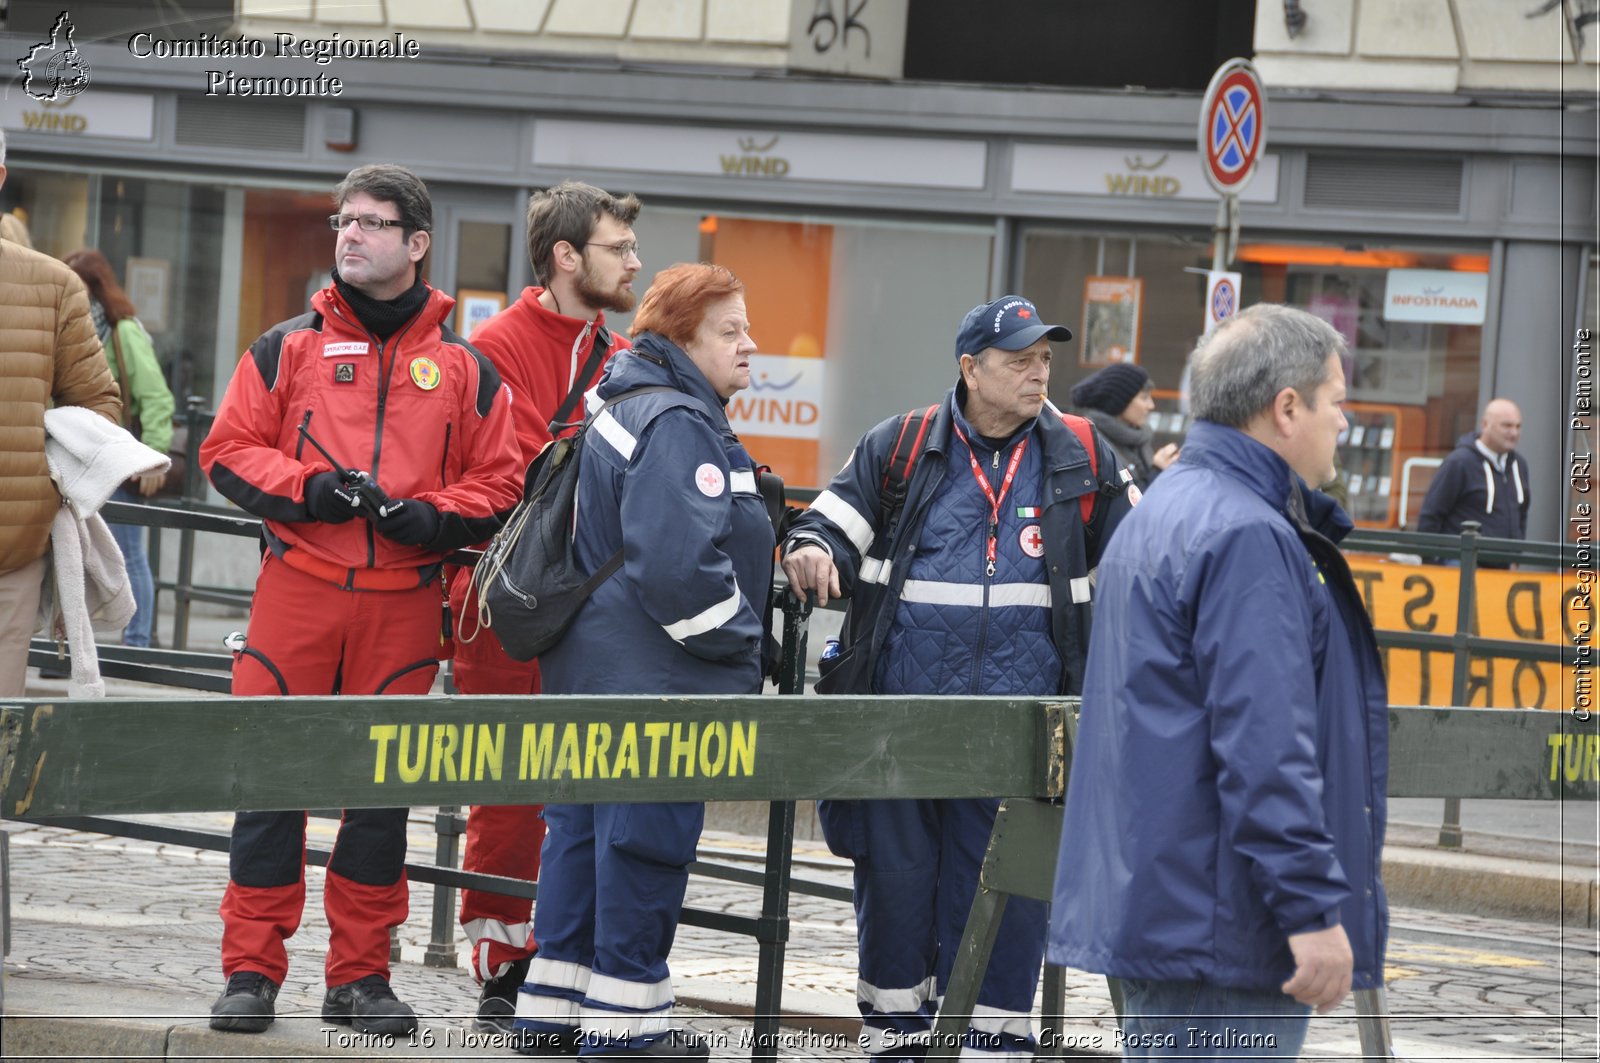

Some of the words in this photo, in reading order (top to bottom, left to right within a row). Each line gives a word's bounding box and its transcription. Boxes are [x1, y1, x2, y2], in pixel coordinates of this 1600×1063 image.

[22, 110, 87, 131] WIND
[720, 154, 790, 176] WIND
[1105, 172, 1181, 194] WIND
[1392, 294, 1479, 309] INFOSTRADA
[726, 397, 818, 425] WIND
[369, 723, 506, 783] TURIN
[518, 721, 758, 780] MARATHON
